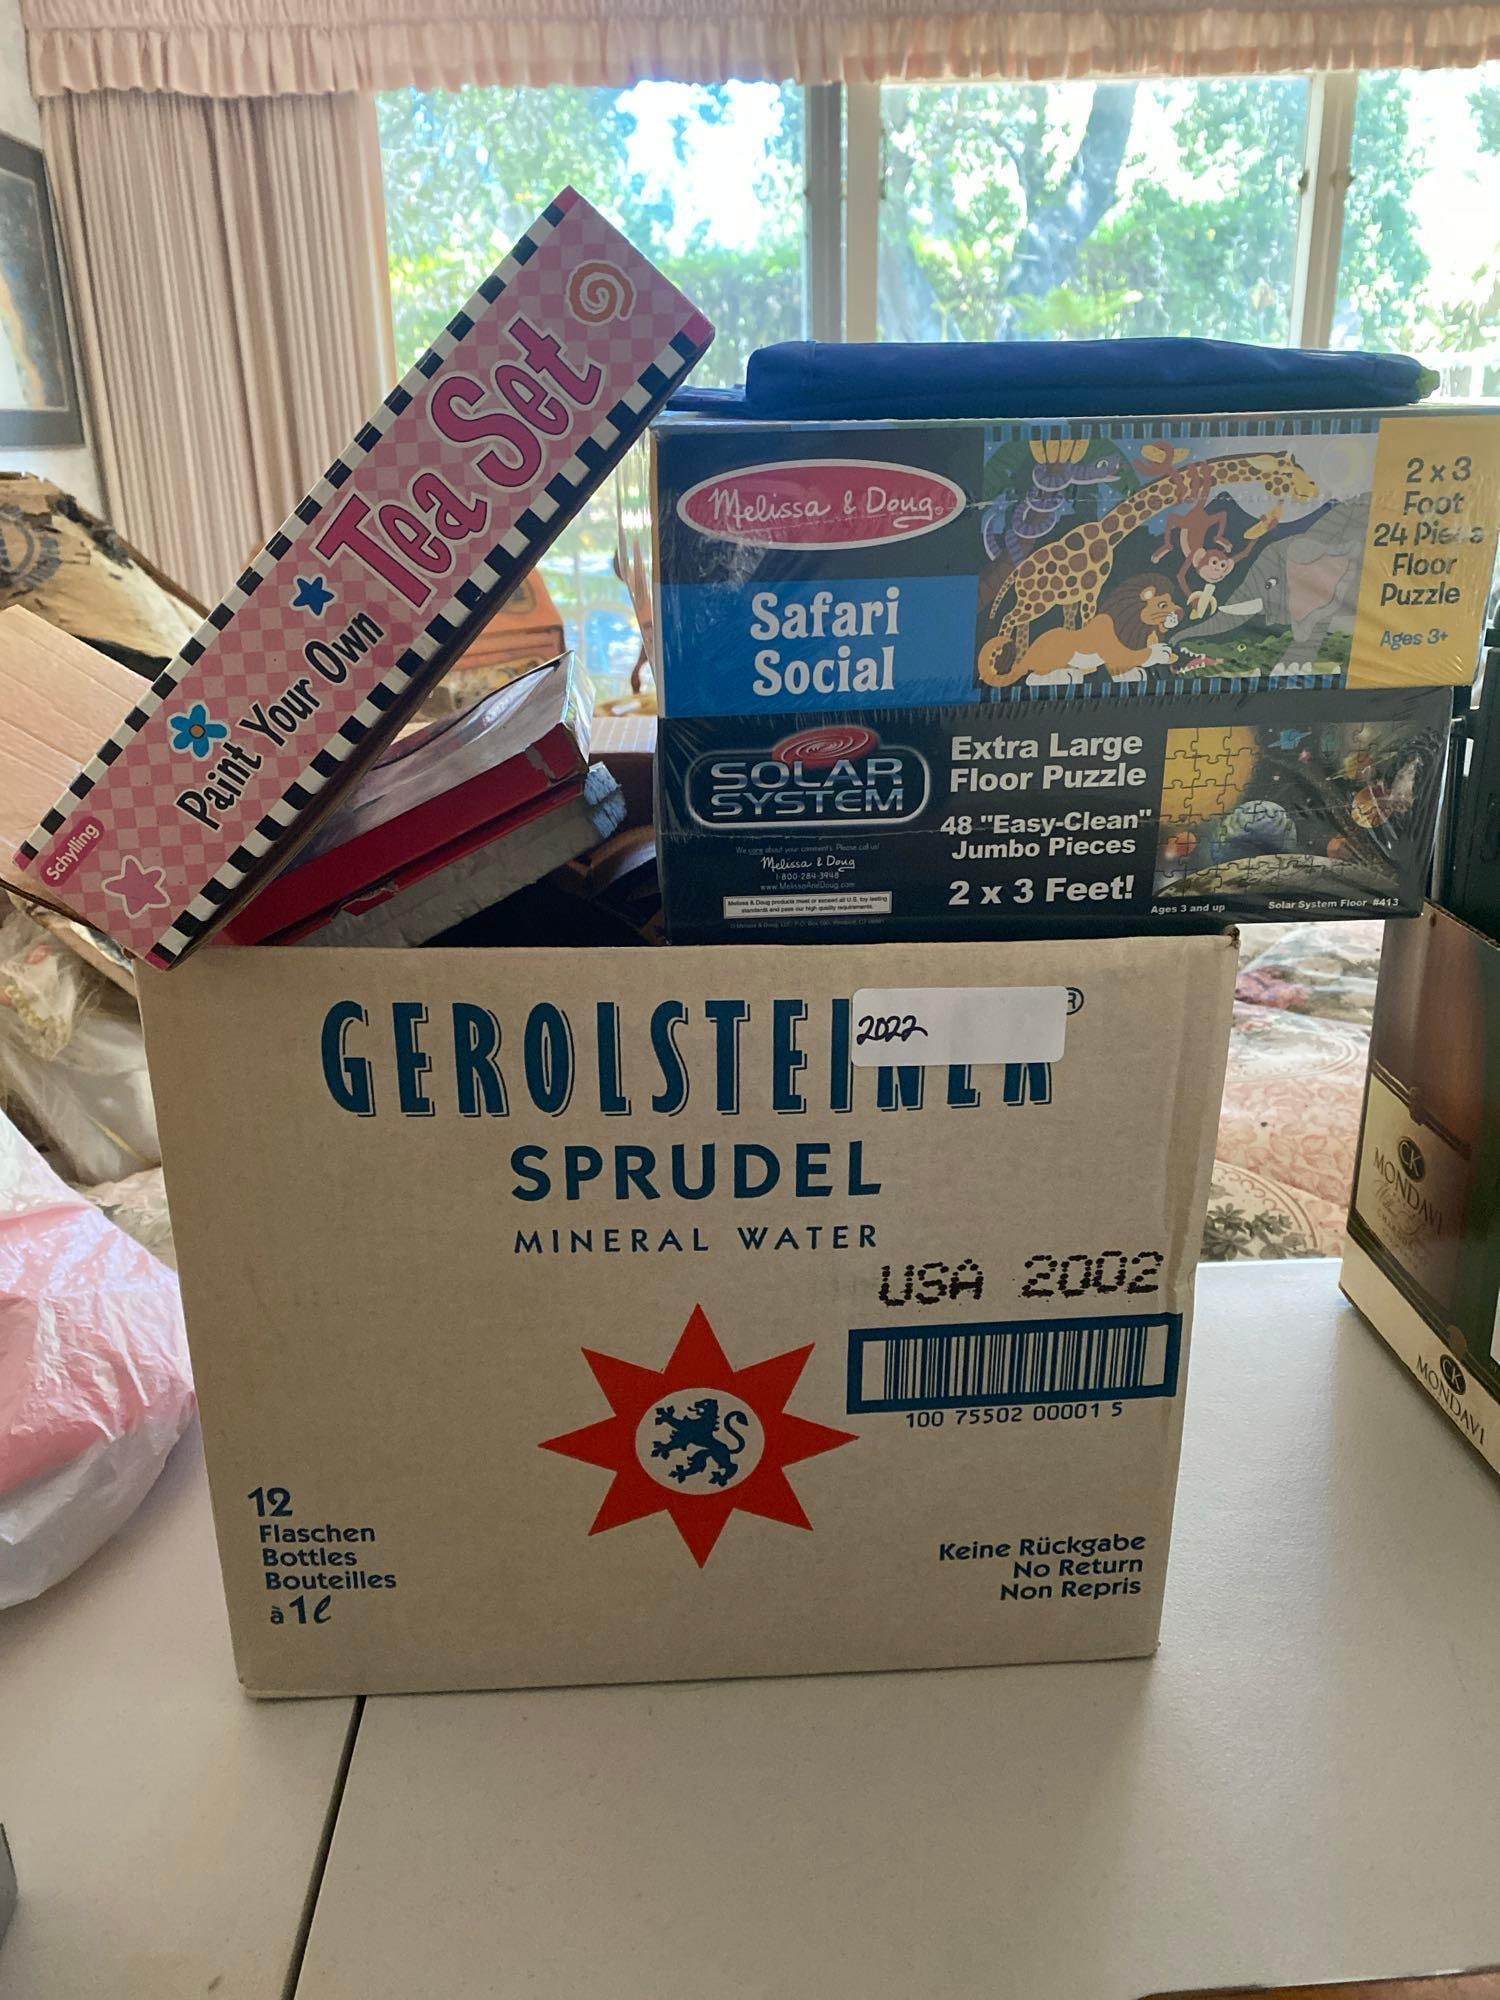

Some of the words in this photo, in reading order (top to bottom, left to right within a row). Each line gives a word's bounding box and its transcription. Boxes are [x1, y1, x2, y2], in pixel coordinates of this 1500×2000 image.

[318, 469, 488, 608] Tea
[430, 314, 602, 488] Set
[1406, 457, 1424, 483] 2
[1429, 464, 1446, 482] x
[1452, 455, 1472, 481] 3
[708, 488, 830, 528] Melissa
[843, 488, 857, 512] &
[867, 486, 933, 528] Doug
[1403, 491, 1465, 516] Foot
[1374, 522, 1408, 547] 24
[1392, 552, 1458, 576] Floor
[1380, 582, 1460, 606] Puzzle
[749, 586, 900, 641] Safari
[1380, 630, 1422, 651] Ages
[1427, 628, 1448, 645] 3+
[753, 644, 895, 697] Social
[176, 742, 261, 831] Paint
[239, 678, 320, 747] Your
[304, 612, 384, 683] Own
[952, 736, 1038, 760] Extra
[1050, 733, 1142, 761] Large
[711, 758, 902, 790] SOLAR
[950, 768, 1033, 792] Floor
[1042, 763, 1147, 790] Puzzle
[712, 788, 903, 816] SYSTEM
[940, 815, 972, 835] 48
[980, 809, 1152, 837] "Easy-Clean"
[46, 823, 100, 881] Schylling
[736, 846, 747, 855] We
[836, 843, 857, 851] Please
[952, 839, 1040, 860] Jumbo
[1049, 836, 1136, 856] Pieces
[761, 856, 812, 871] Melissa
[816, 857, 822, 867] &
[827, 855, 856, 872] Doug
[949, 880, 970, 905] 2
[980, 885, 1002, 904] x
[1013, 878, 1034, 904] 3
[1045, 875, 1135, 902] Feet!
[1268, 901, 1296, 910] Solar
[1298, 900, 1337, 910] System
[1340, 899, 1367, 908] Floor
[1373, 898, 1400, 907] #413
[805, 904, 818, 912] high
[1150, 905, 1177, 914] Ages
[1180, 904, 1187, 913] 3
[1190, 904, 1209, 912] and
[1212, 904, 1225, 913] up
[856, 1015, 928, 1045] 2022
[510, 1140, 882, 1201] SPRUDEL
[1400, 1140, 1423, 1178] CK
[1374, 1147, 1442, 1234] MONDAVI
[514, 1227, 709, 1253] MINERAL
[737, 1224, 877, 1251] WATER
[878, 1258, 984, 1306] USA
[1021, 1251, 1164, 1298] 2002
[1442, 1357, 1463, 1393] CK
[1416, 1354, 1484, 1445] MONDAVI
[906, 1411, 944, 1428] 100
[956, 1407, 1022, 1426] 75502
[1033, 1403, 1100, 1422] 00001
[1111, 1401, 1123, 1417] 5
[247, 1486, 293, 1517] 12
[259, 1523, 376, 1543] Flaschen
[939, 1541, 1010, 1561] Keine
[1019, 1533, 1146, 1560] Rückgabe
[262, 1548, 358, 1566] Bottles
[1013, 1560, 1050, 1579] No
[1059, 1556, 1143, 1577] Return
[265, 1571, 397, 1590] Bouteilles
[1000, 1582, 1052, 1601] Non
[1061, 1577, 1141, 1600] Repris
[270, 1605, 284, 1625] à
